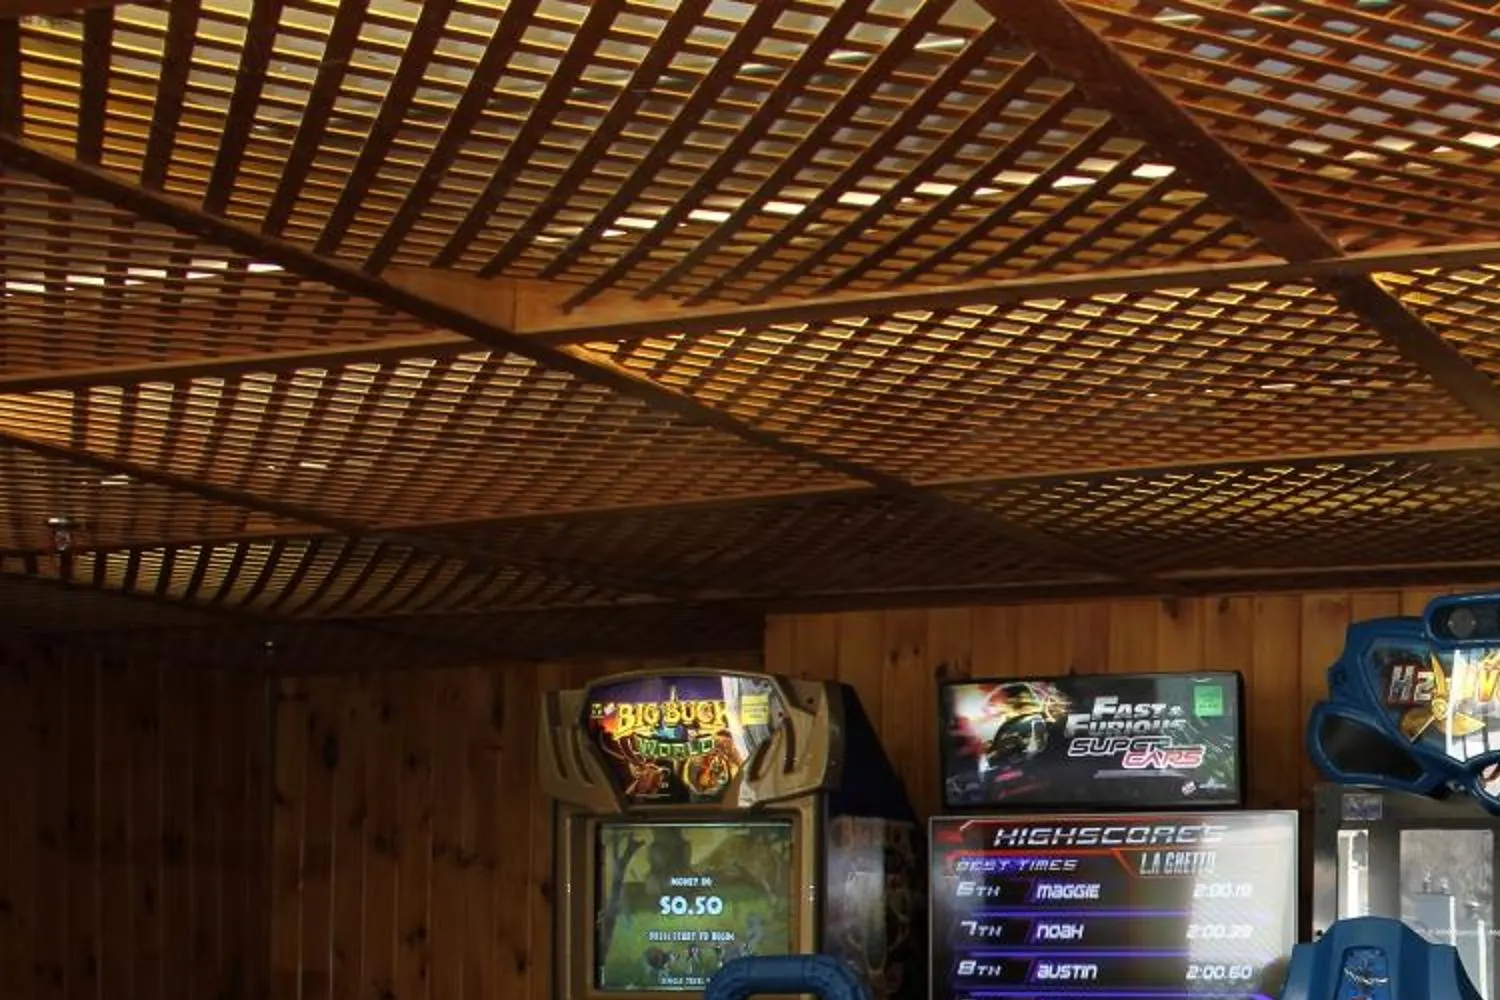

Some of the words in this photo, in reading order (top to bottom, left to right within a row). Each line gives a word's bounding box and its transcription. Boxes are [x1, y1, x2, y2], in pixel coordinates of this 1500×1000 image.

[1092, 695, 1166, 719] FAST
[613, 703, 661, 740] BIG
[662, 701, 729, 731] BUCK
[1065, 713, 1187, 739] FURIOUS
[1067, 735, 1172, 757] SUPER
[1122, 744, 1206, 769] CARS
[993, 825, 1228, 847] HIGHSCORES
[1019, 859, 1079, 871] TIMES
[960, 920, 1002, 936] 7TH
[957, 959, 1002, 976] 8TH
